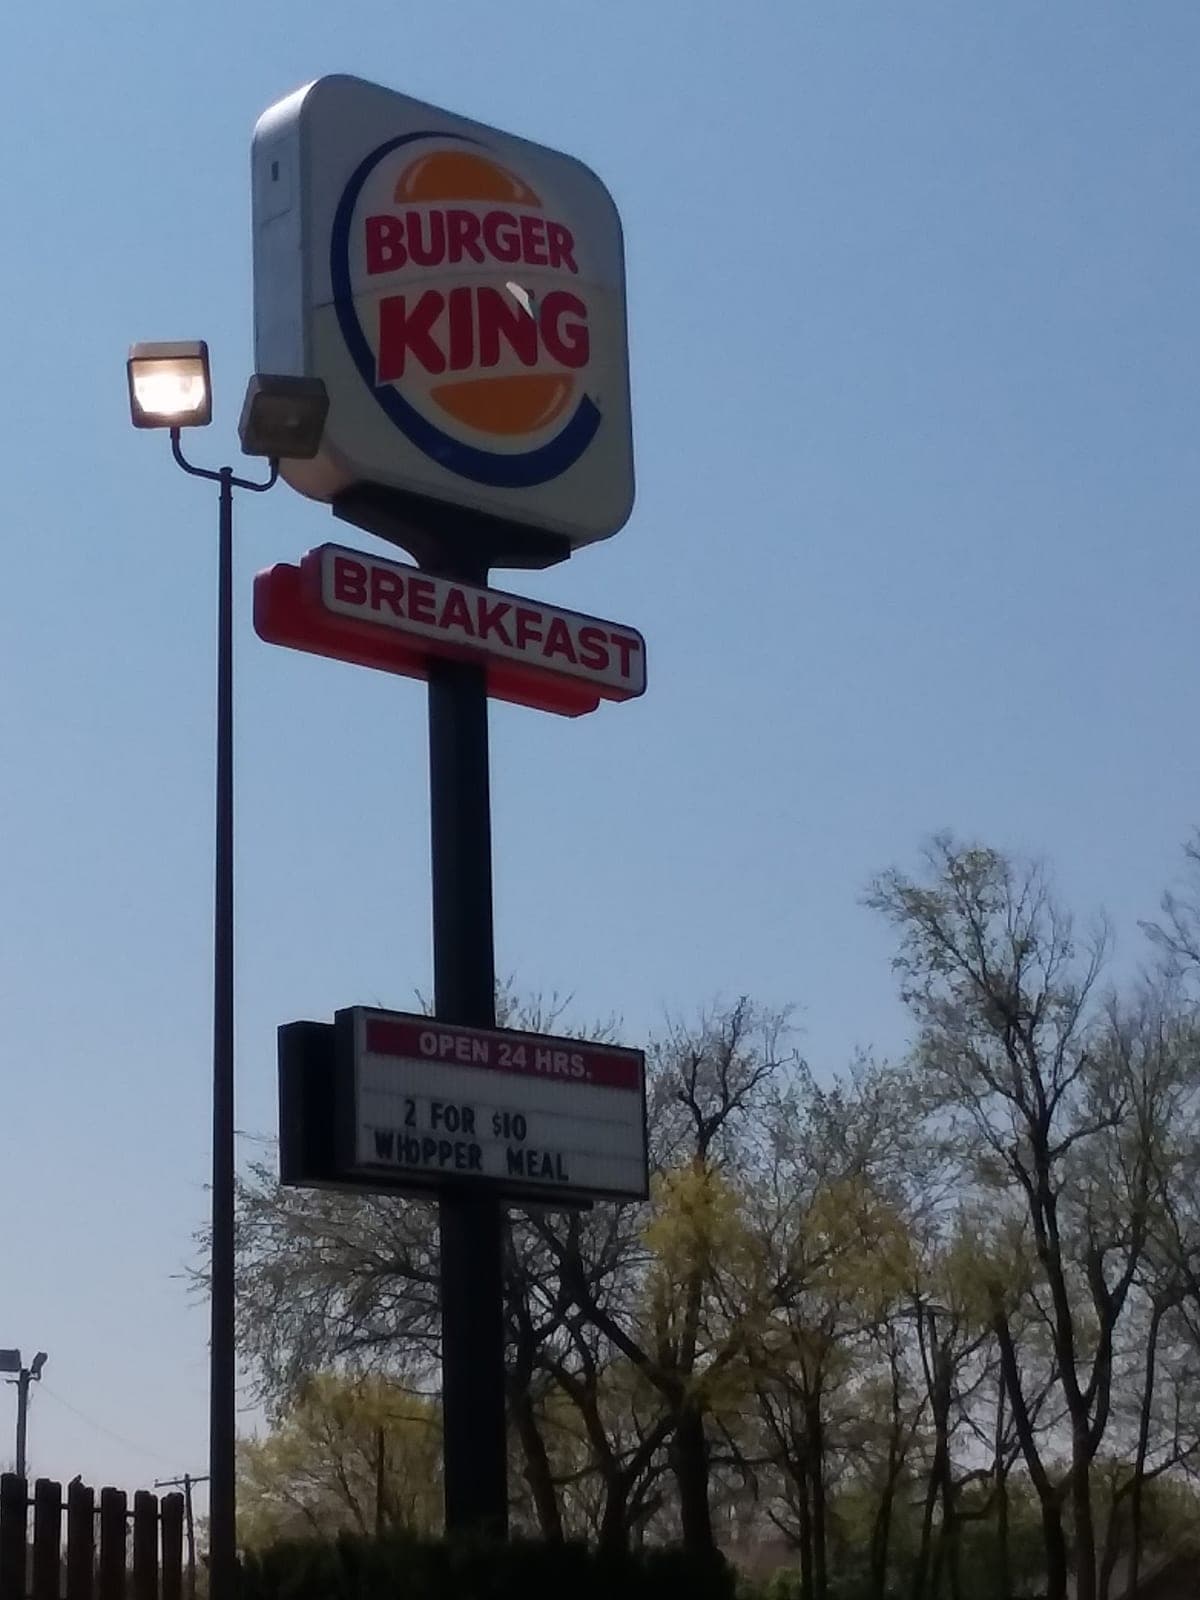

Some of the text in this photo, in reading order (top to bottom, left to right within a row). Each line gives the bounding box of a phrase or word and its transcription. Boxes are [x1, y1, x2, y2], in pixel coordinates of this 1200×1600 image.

[365, 210, 578, 274] BURGER
[375, 287, 590, 382] KING
[333, 556, 639, 678] BREAKFAST
[419, 1031, 592, 1079] OPEN 24 HRS.
[404, 1099, 527, 1141] 2 FOR $10
[374, 1130, 569, 1181] WHOPPER MEAL
